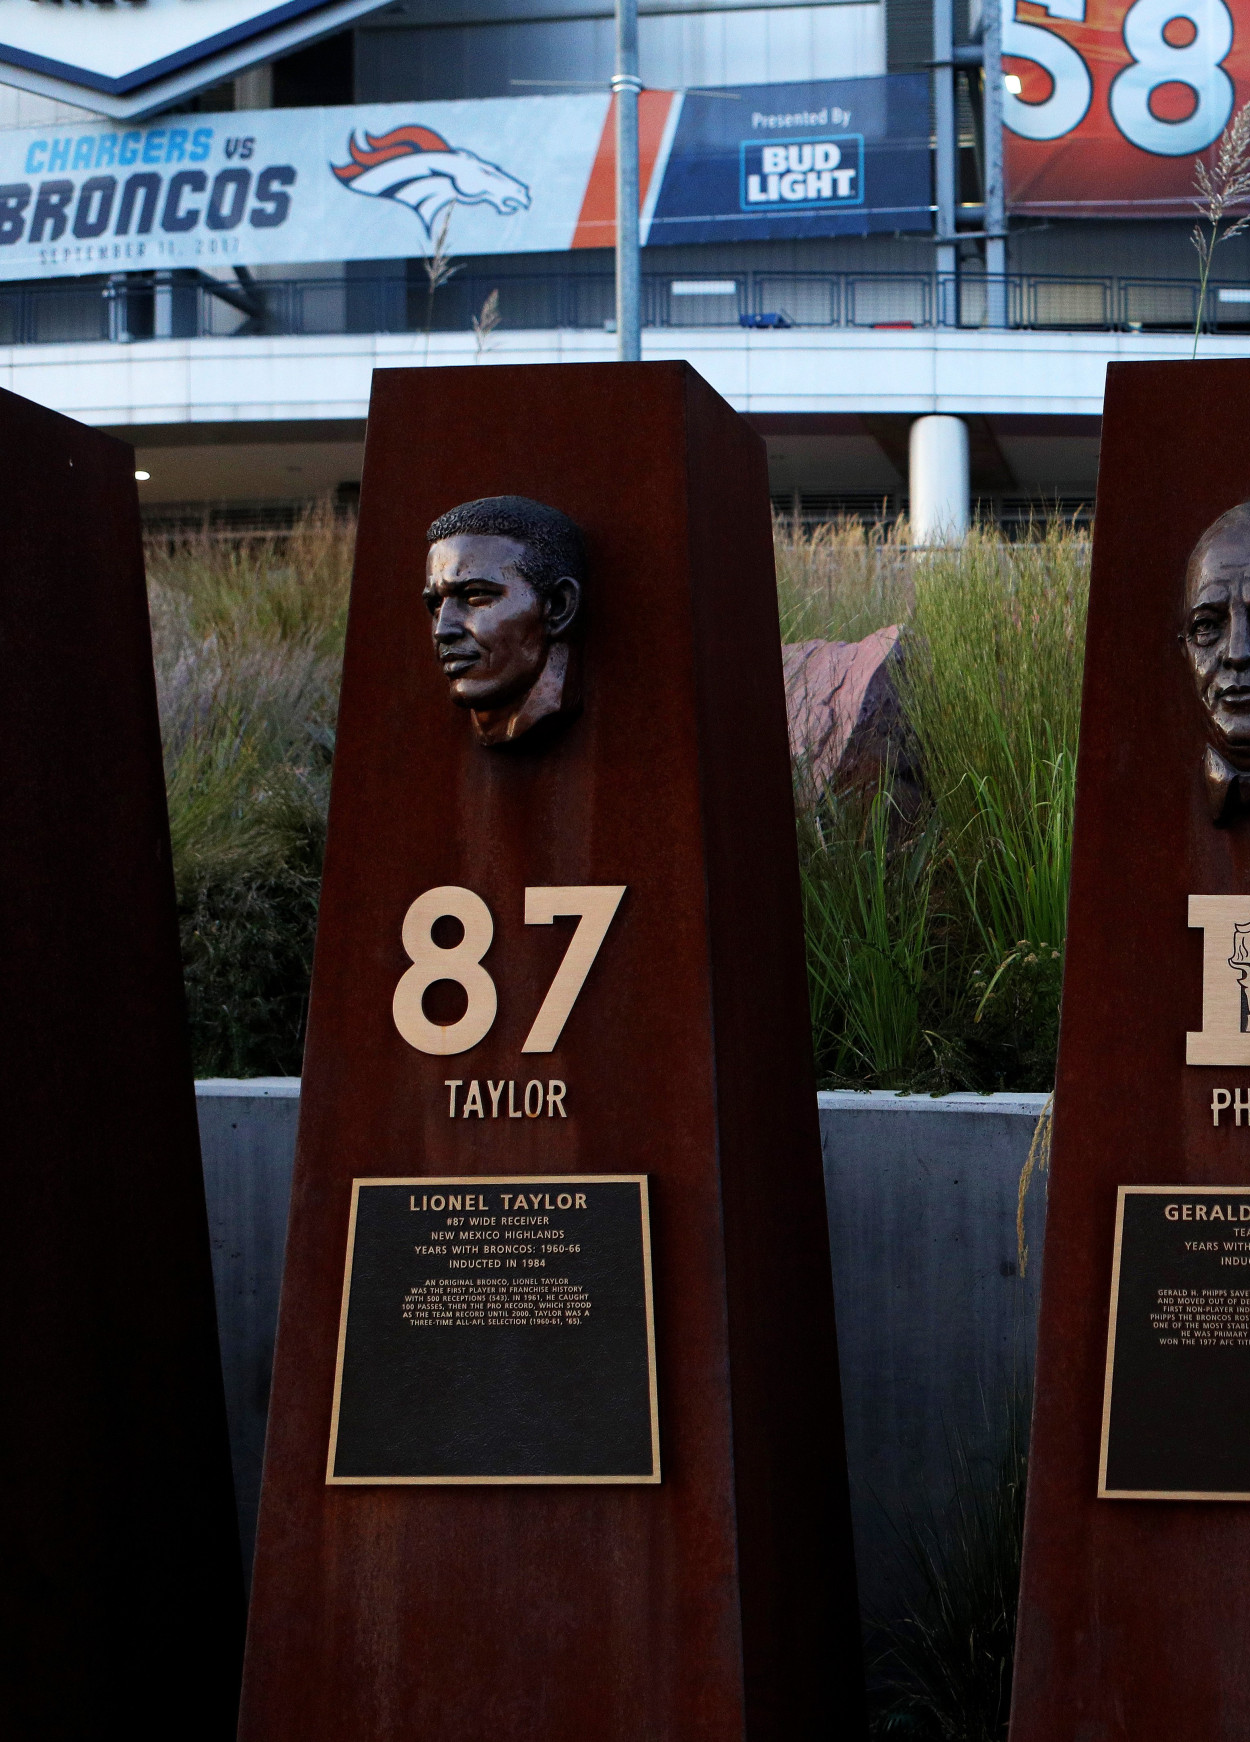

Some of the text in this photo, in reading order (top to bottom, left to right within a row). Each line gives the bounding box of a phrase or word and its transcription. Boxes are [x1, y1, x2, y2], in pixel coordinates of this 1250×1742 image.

[751, 106, 852, 129] Presented By
[24, 128, 256, 175] CHARGERS VS
[762, 142, 842, 175] BUD
[747, 168, 857, 203] LIGHT
[0, 164, 297, 246] BRONCOS
[393, 885, 628, 1056] 87
[445, 1079, 568, 1119] TAYLOR
[410, 1193, 587, 1212] LIONEL TAYLOR
[446, 1216, 549, 1226] #87 WIDE RECEIVER
[431, 1231, 565, 1241] NEW MEXICO HIGHLANDS
[414, 1245, 581, 1255] YEARS WITH BRONCOS: 1960-66
[1184, 1242, 1219, 1251] YEARS
[1223, 1242, 1250, 1252] WITH
[449, 1259, 546, 1269] INDUCTED IN 1984
[1157, 1289, 1188, 1297] GERALD
[1196, 1314, 1232, 1322] BRONCOS
